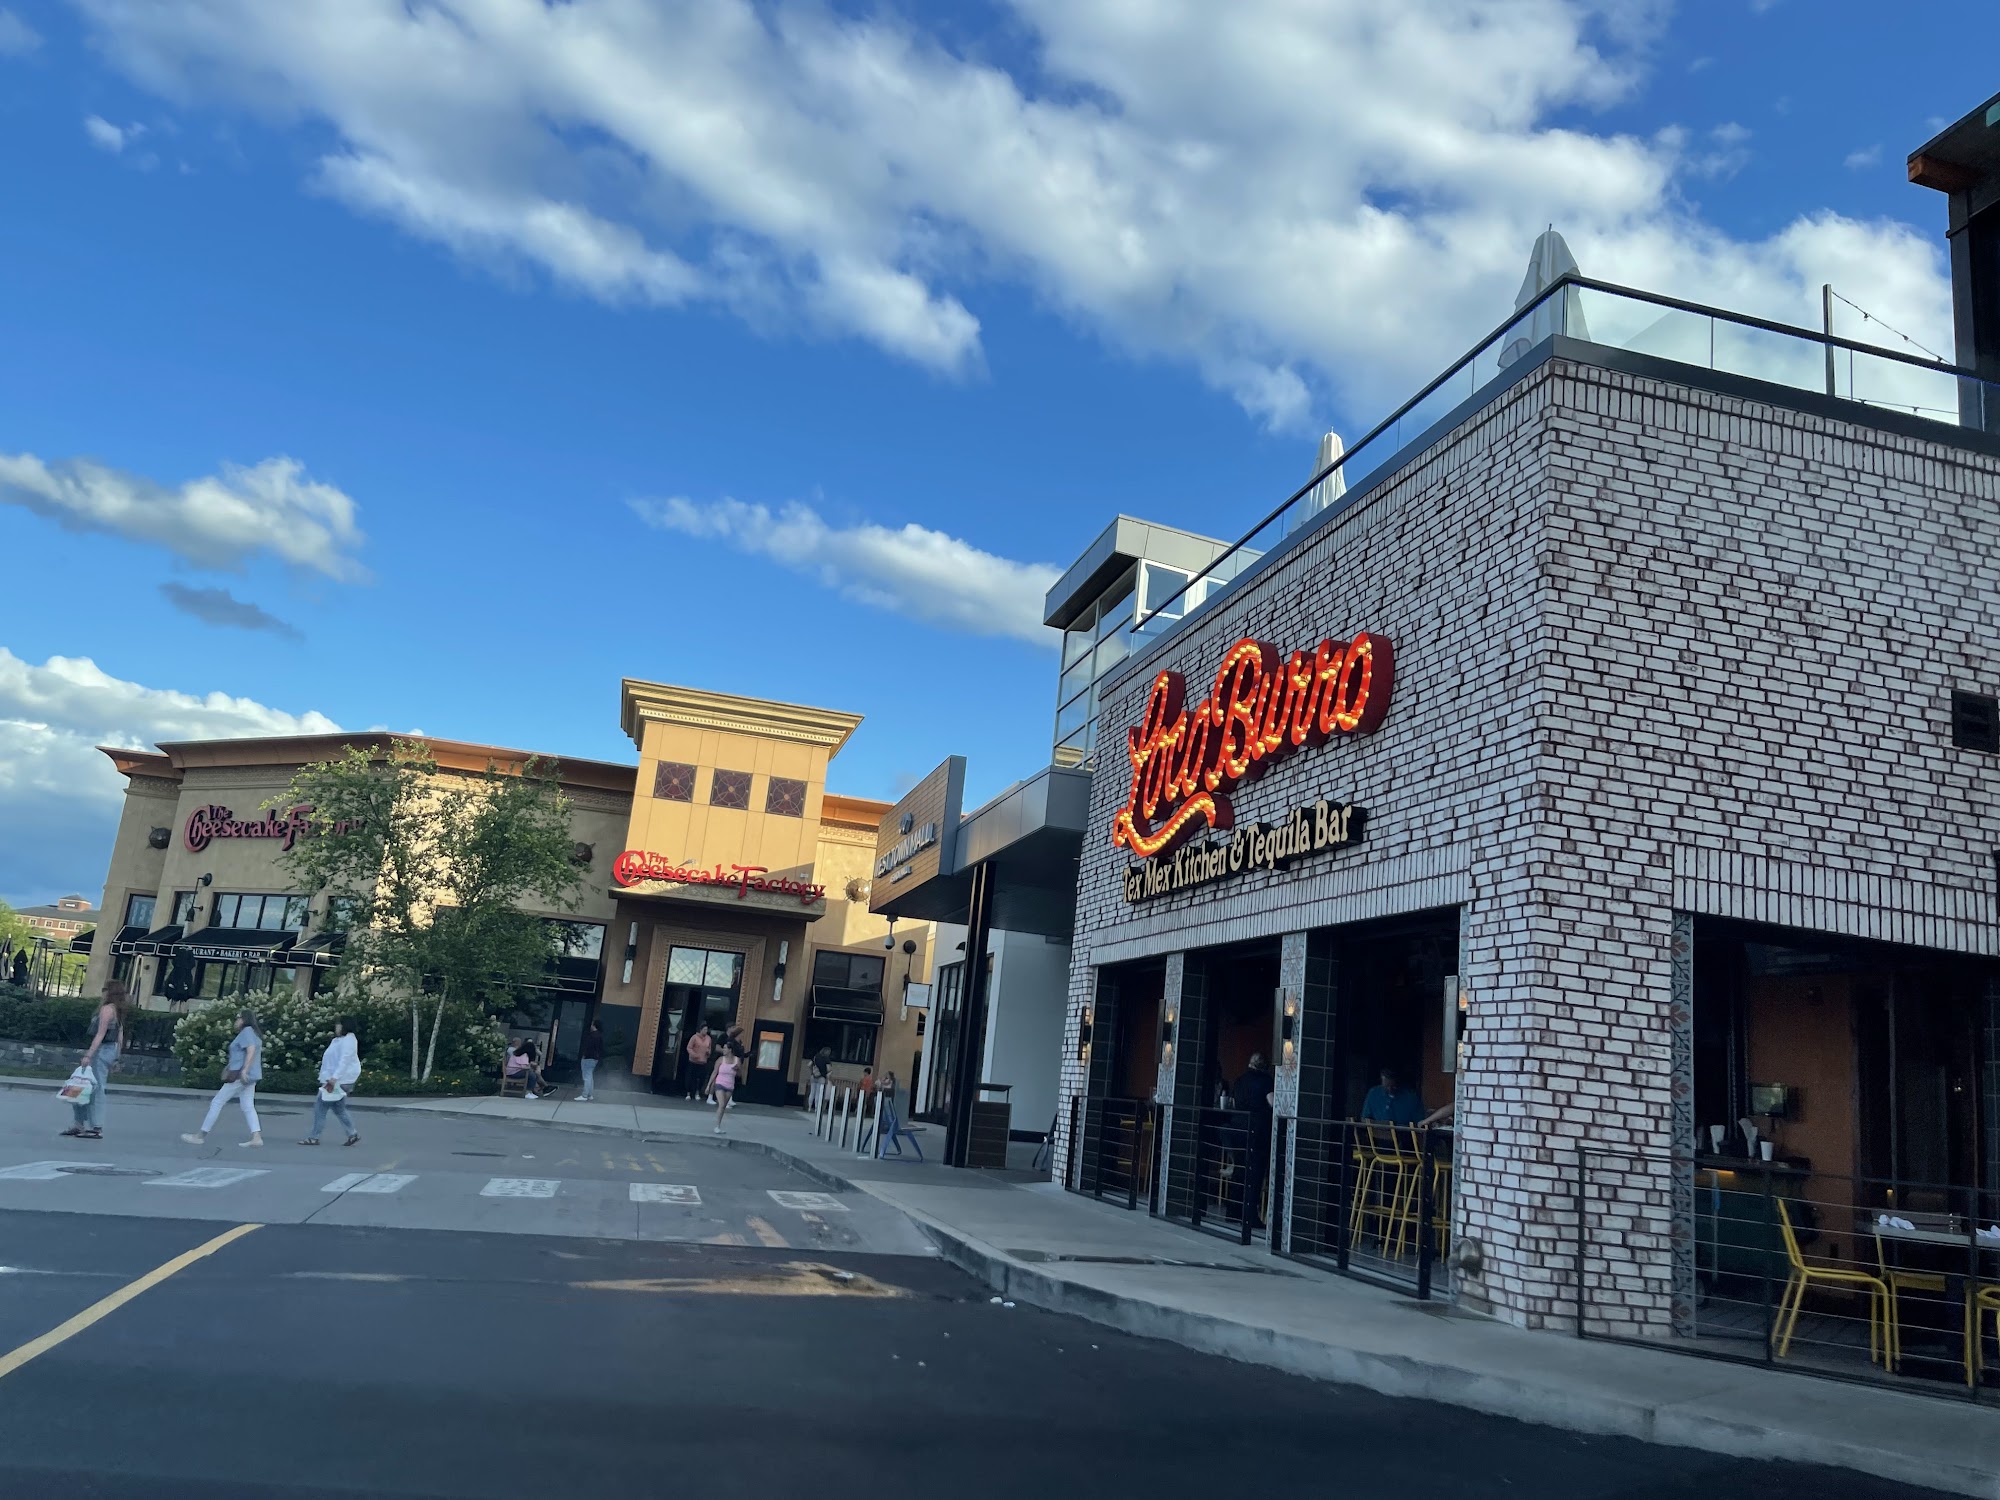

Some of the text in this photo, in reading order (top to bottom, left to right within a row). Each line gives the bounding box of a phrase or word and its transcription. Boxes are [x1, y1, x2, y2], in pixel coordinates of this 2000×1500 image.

[1113, 632, 1374, 857] Loco Burro
[184, 805, 288, 852] Cheesecake
[211, 805, 230, 819] The
[647, 851, 669, 864] The
[1122, 799, 1352, 903] Tex Mex Kitchen & Tequila Bar
[613, 850, 827, 905] Cheesecake Factory
